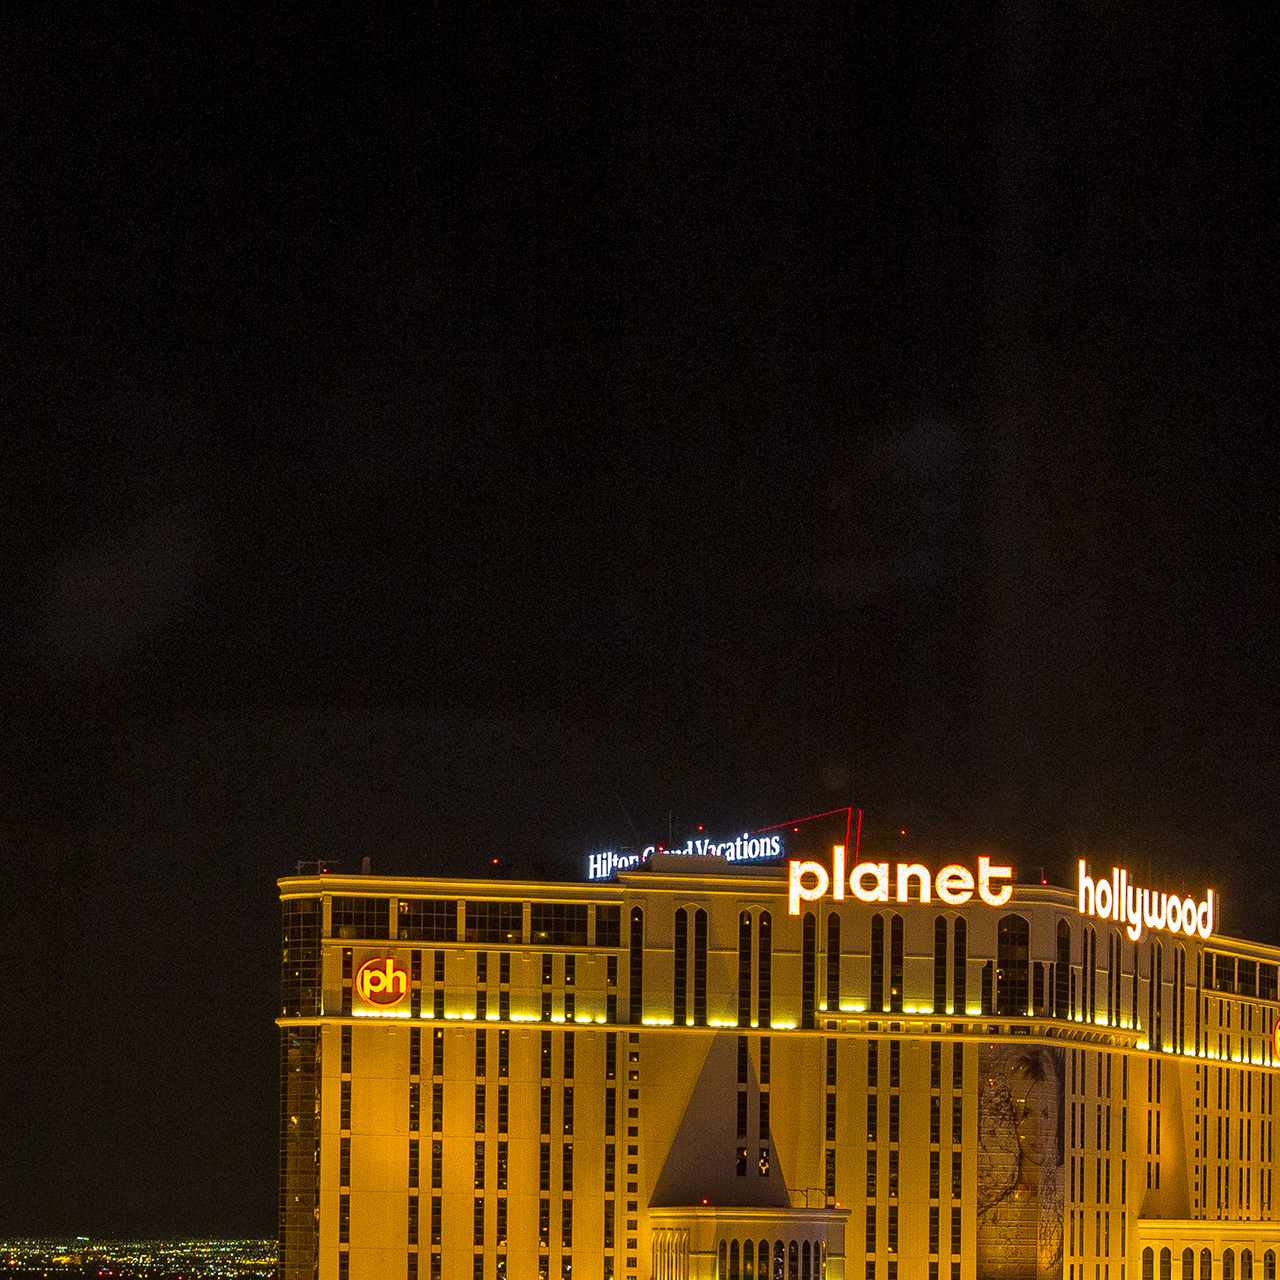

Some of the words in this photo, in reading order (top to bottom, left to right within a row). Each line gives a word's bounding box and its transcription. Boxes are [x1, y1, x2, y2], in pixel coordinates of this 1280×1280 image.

[589, 851, 639, 879] Hilton
[695, 833, 780, 862] Vacations
[788, 845, 1013, 916] planet
[1078, 858, 1214, 941] hollywood
